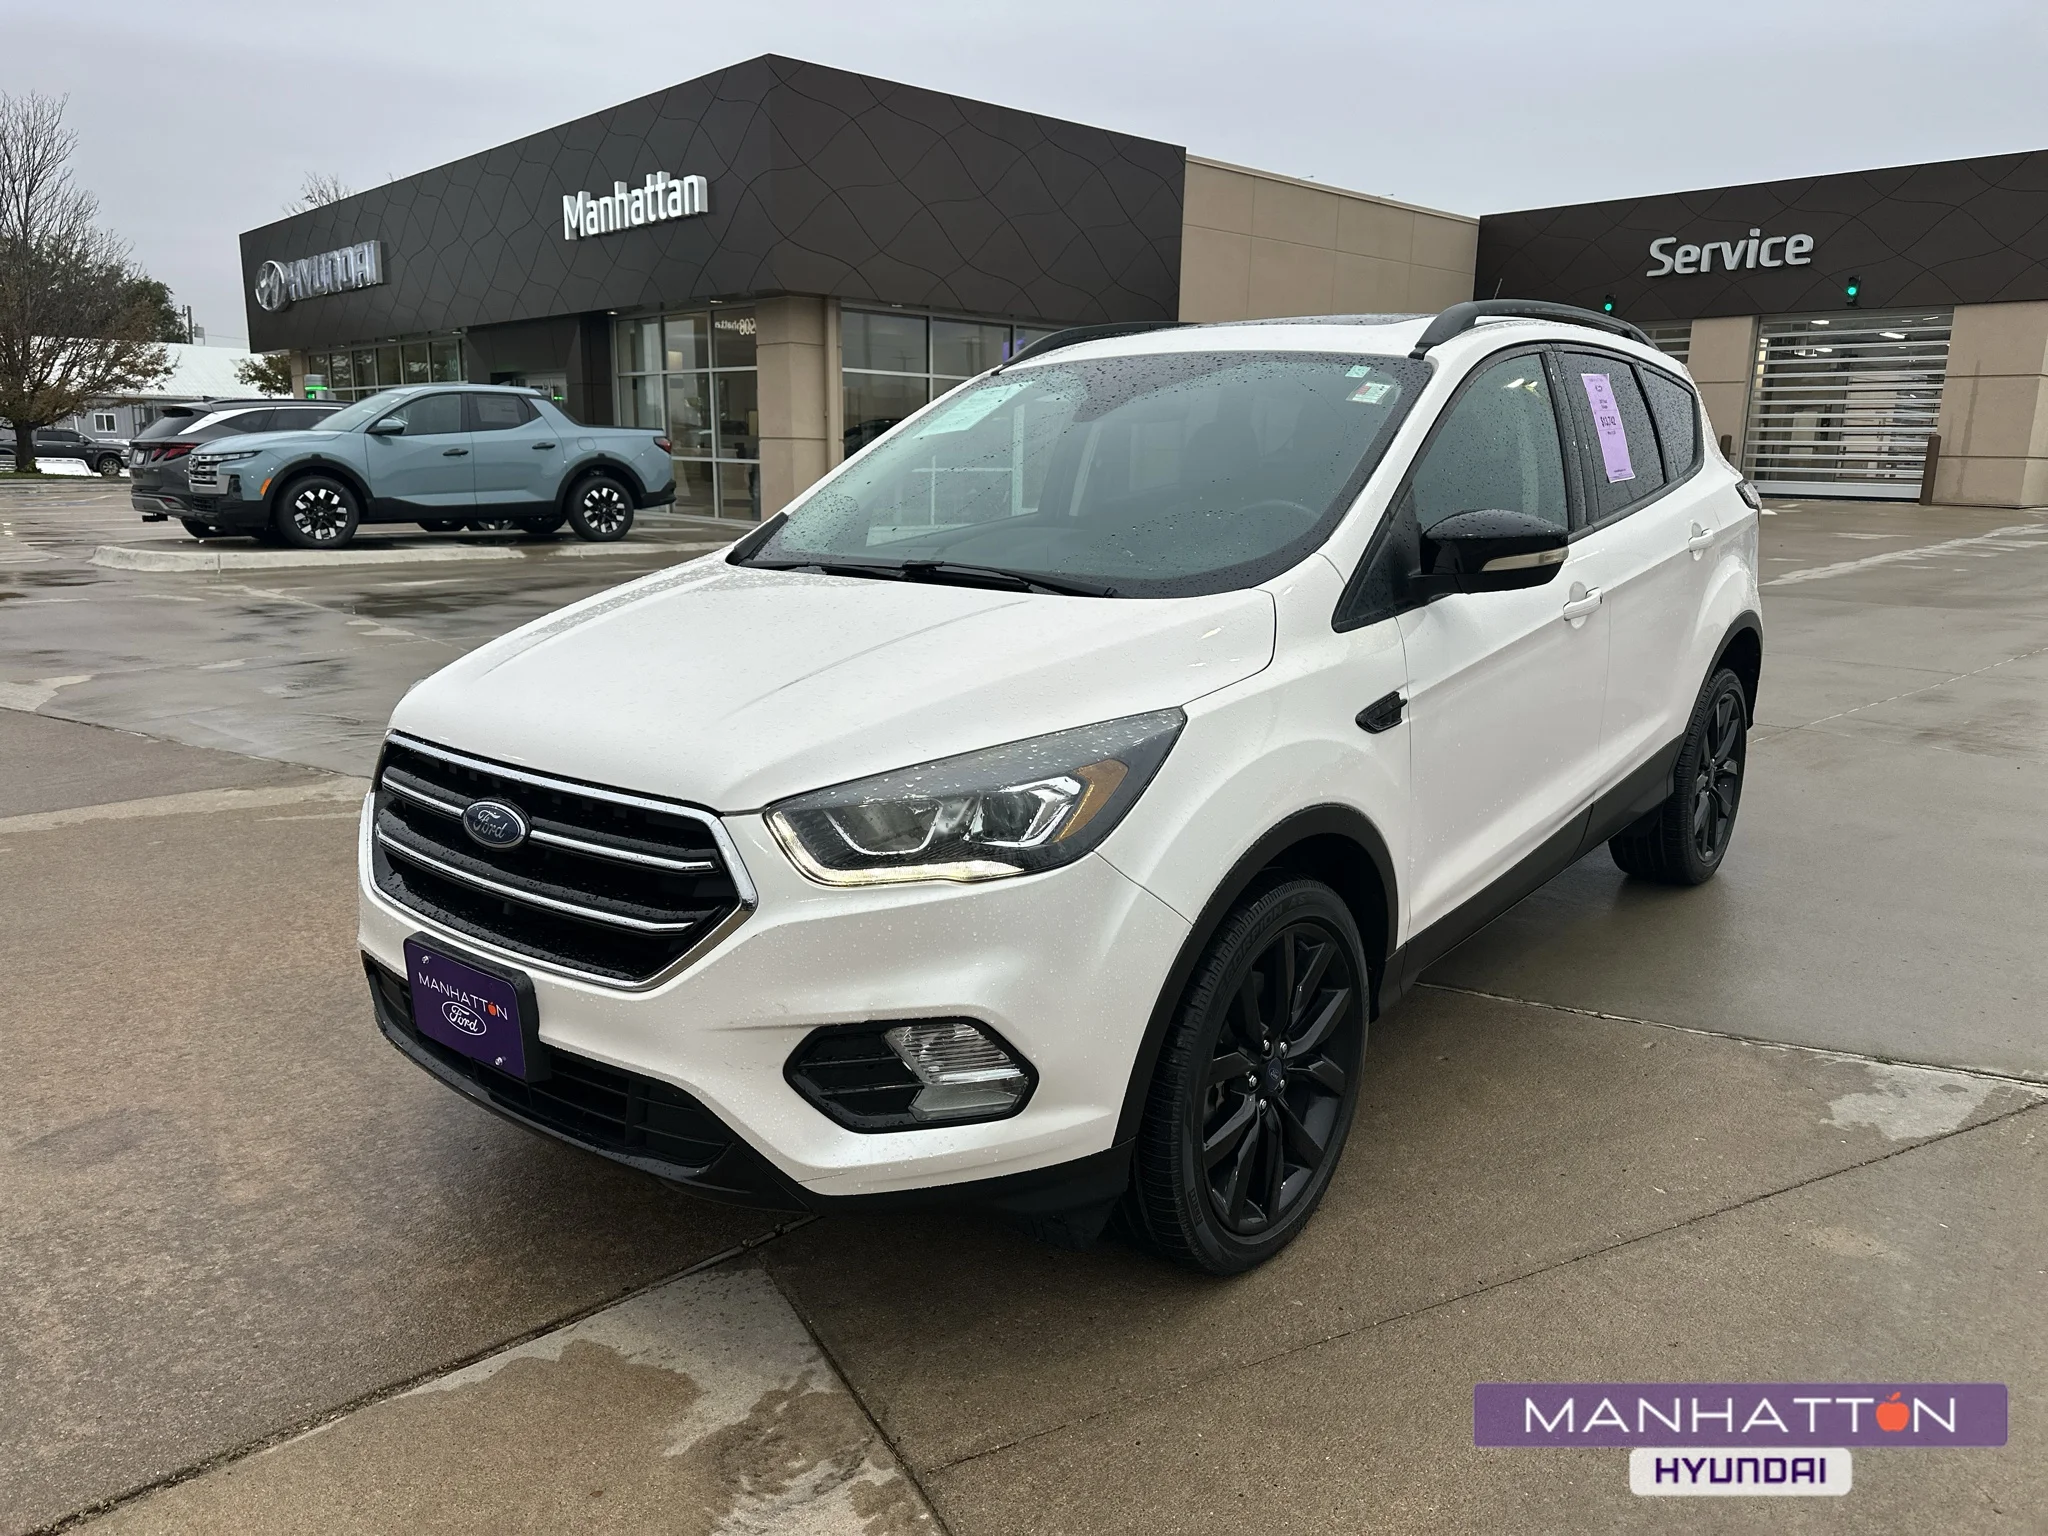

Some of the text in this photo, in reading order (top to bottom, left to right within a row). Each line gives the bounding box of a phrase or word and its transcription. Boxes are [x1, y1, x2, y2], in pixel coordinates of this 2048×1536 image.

[562, 171, 708, 240] Manhattan
[287, 240, 382, 301] HYUNDAI
[1646, 228, 1814, 277] Service
[473, 809, 508, 838] Ford
[449, 1005, 479, 1032] Ford
